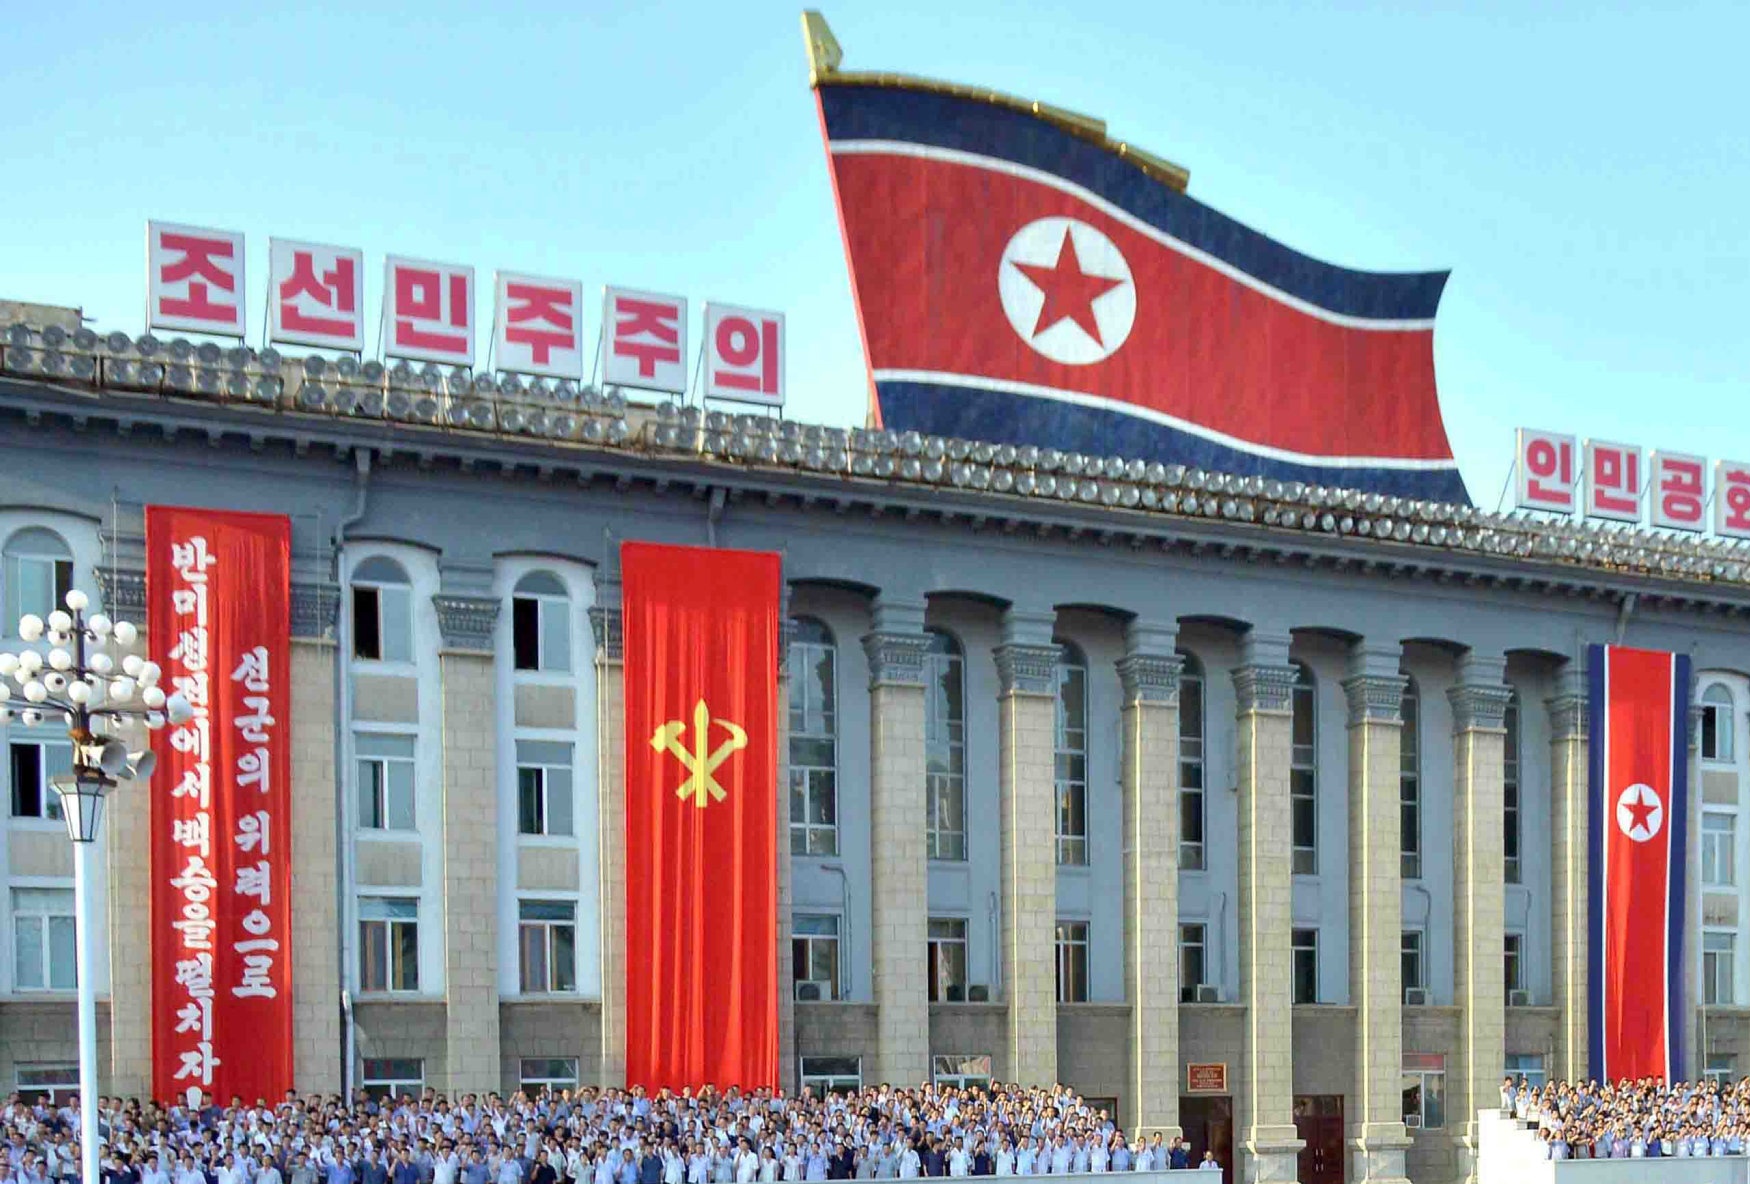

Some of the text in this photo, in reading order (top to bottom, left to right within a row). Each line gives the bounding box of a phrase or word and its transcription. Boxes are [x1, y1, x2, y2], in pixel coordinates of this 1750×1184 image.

[159, 232, 778, 395] 조선민주주의
[231, 646, 279, 998] 선군의 위력으로
